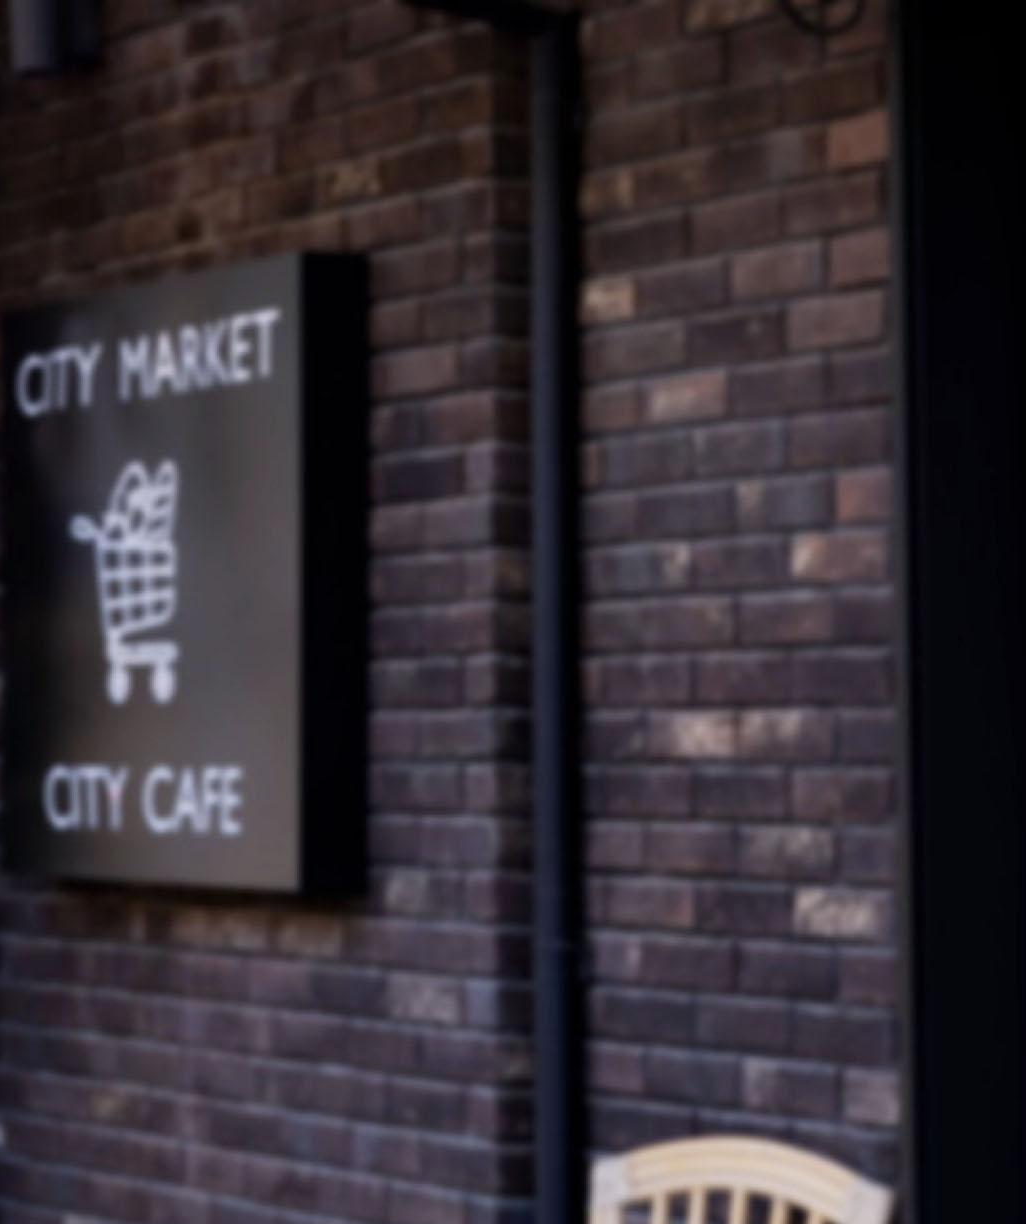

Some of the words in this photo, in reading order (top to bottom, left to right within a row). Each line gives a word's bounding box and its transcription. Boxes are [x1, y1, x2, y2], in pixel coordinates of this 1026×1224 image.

[15, 341, 102, 418] CITY
[119, 307, 281, 403] MARKET
[43, 763, 129, 833] CITY
[141, 763, 245, 837] CAFE
